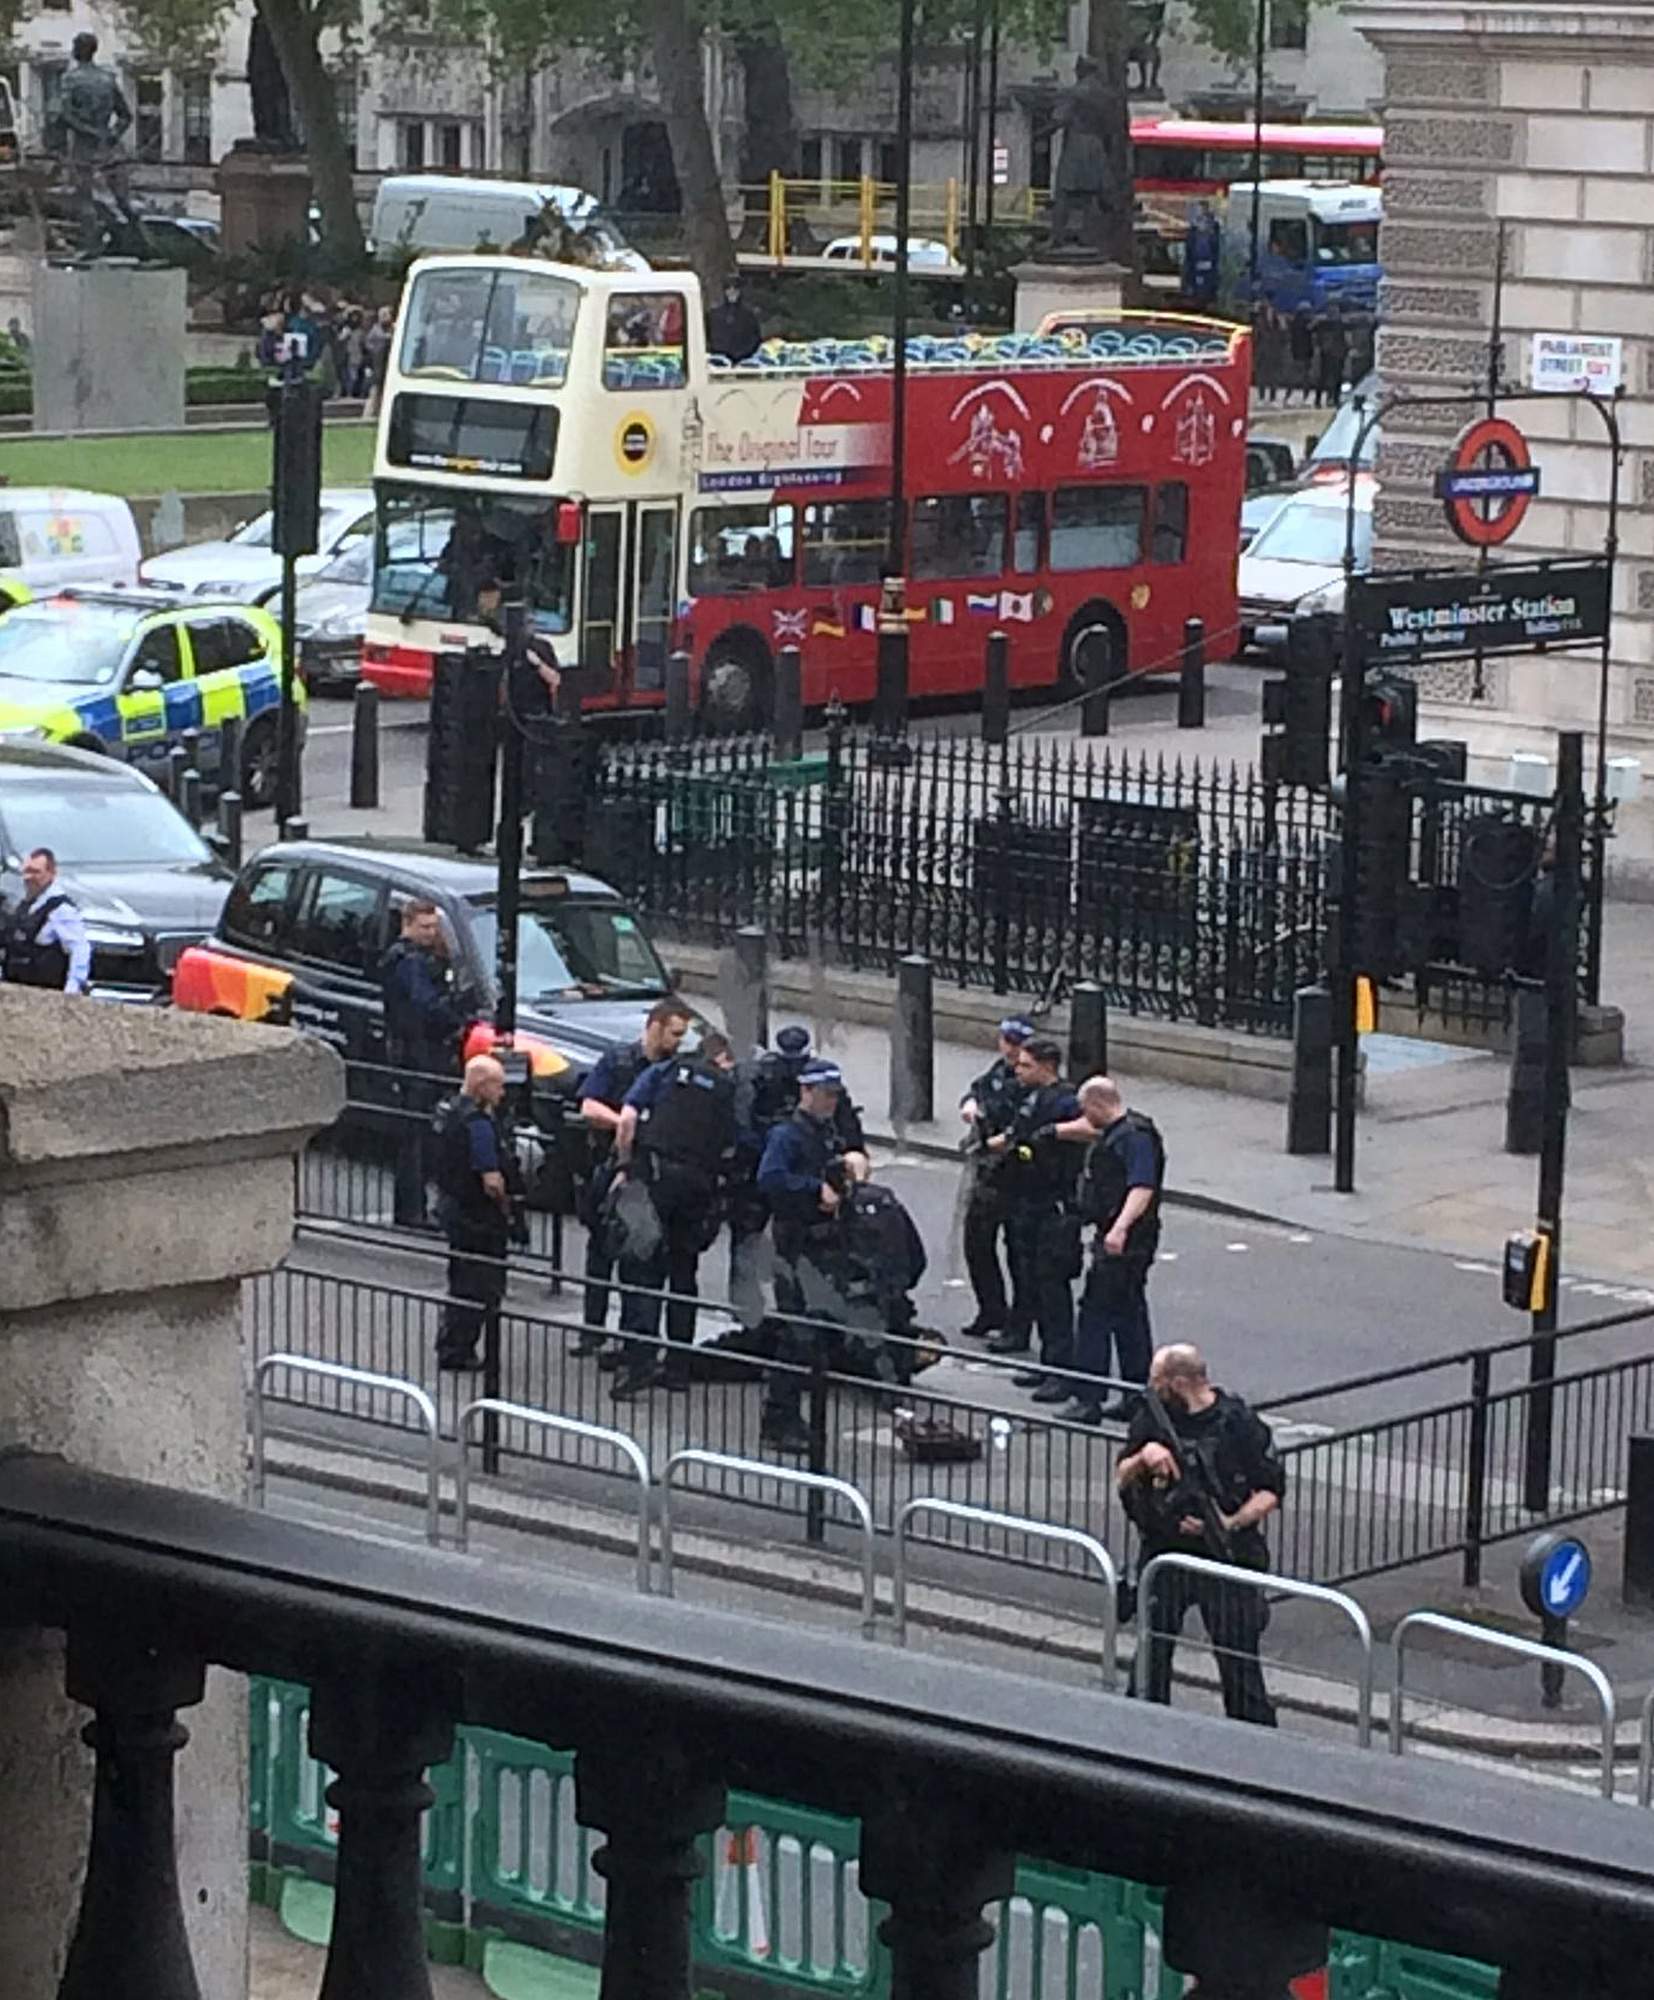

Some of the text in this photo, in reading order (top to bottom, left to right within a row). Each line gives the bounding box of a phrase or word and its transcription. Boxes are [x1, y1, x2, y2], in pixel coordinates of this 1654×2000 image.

[707, 429, 839, 470] The Original Tour
[702, 473, 753, 488] London
[1388, 593, 1576, 630] Westminster Station
